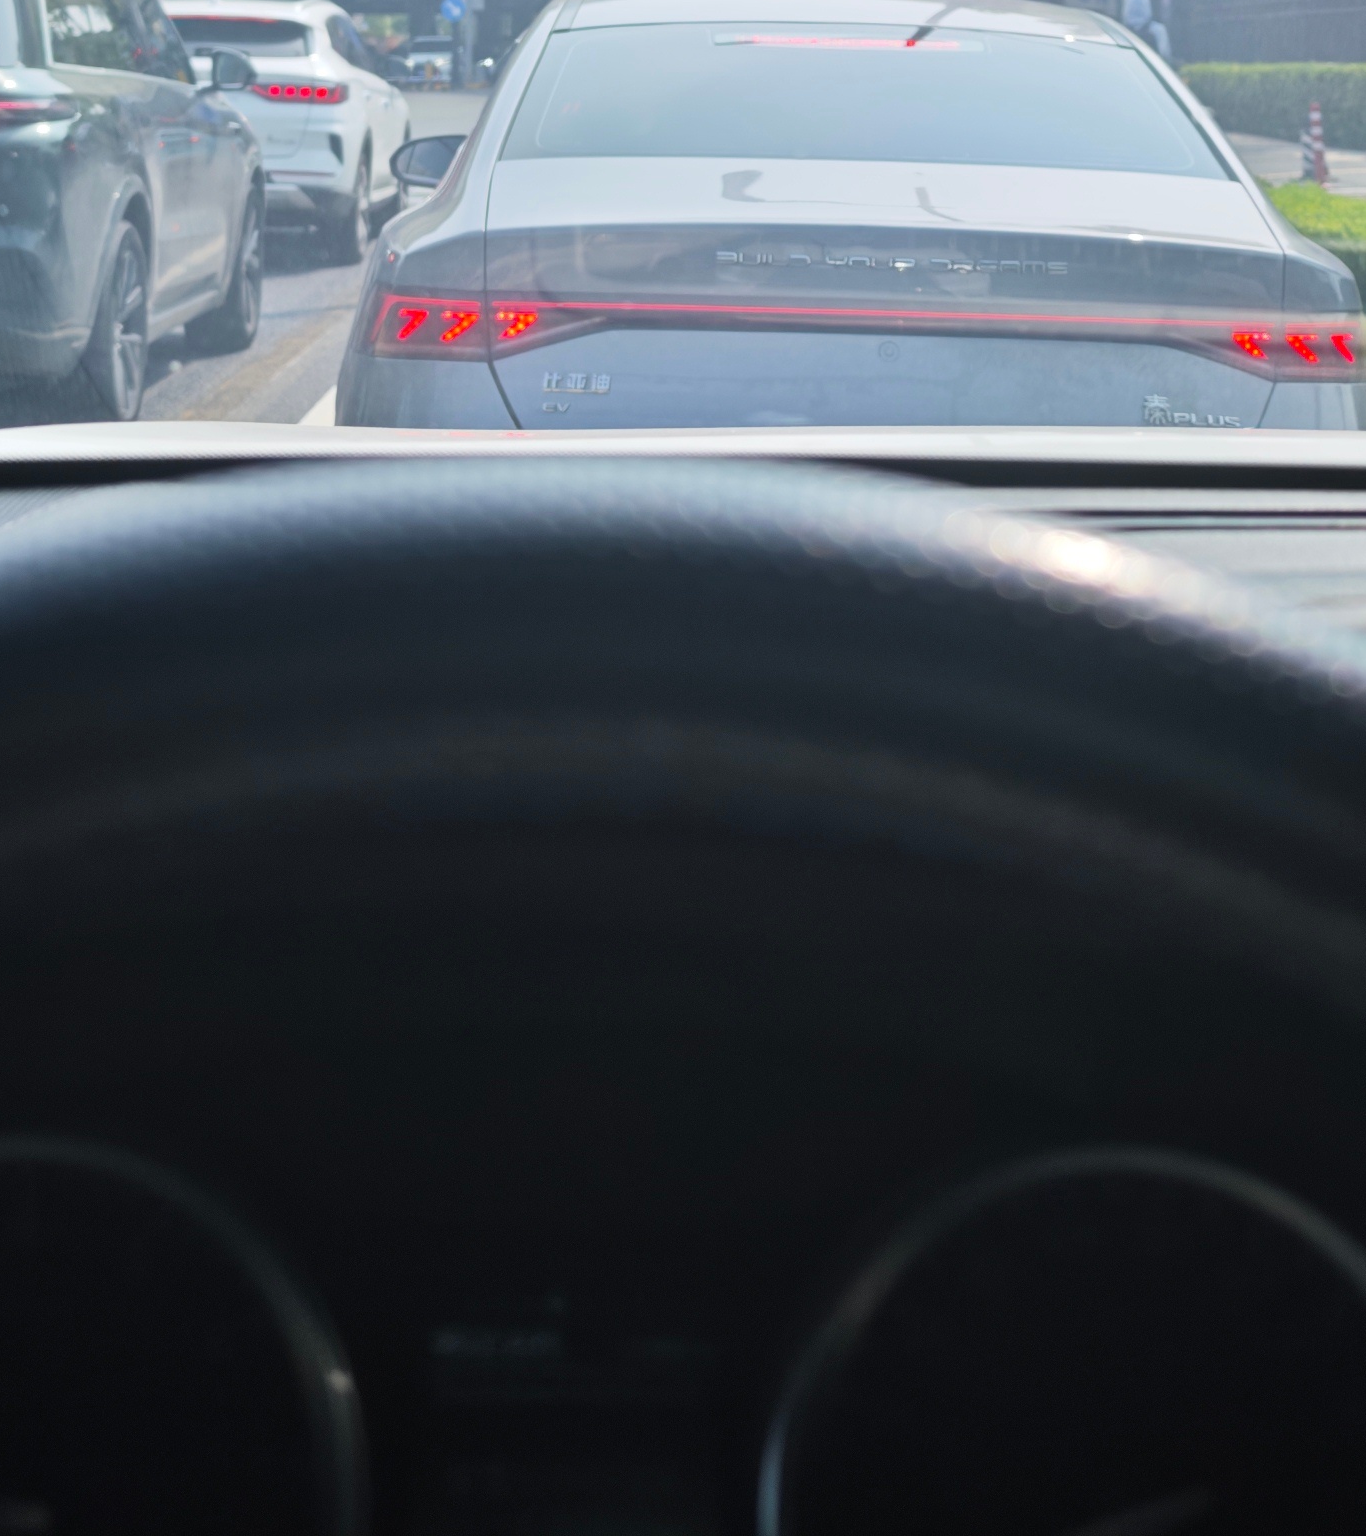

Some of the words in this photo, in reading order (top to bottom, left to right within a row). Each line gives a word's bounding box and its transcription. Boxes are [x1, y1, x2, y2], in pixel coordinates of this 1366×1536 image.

[542, 371, 612, 393] 比亚迪
[542, 401, 571, 413] EV
